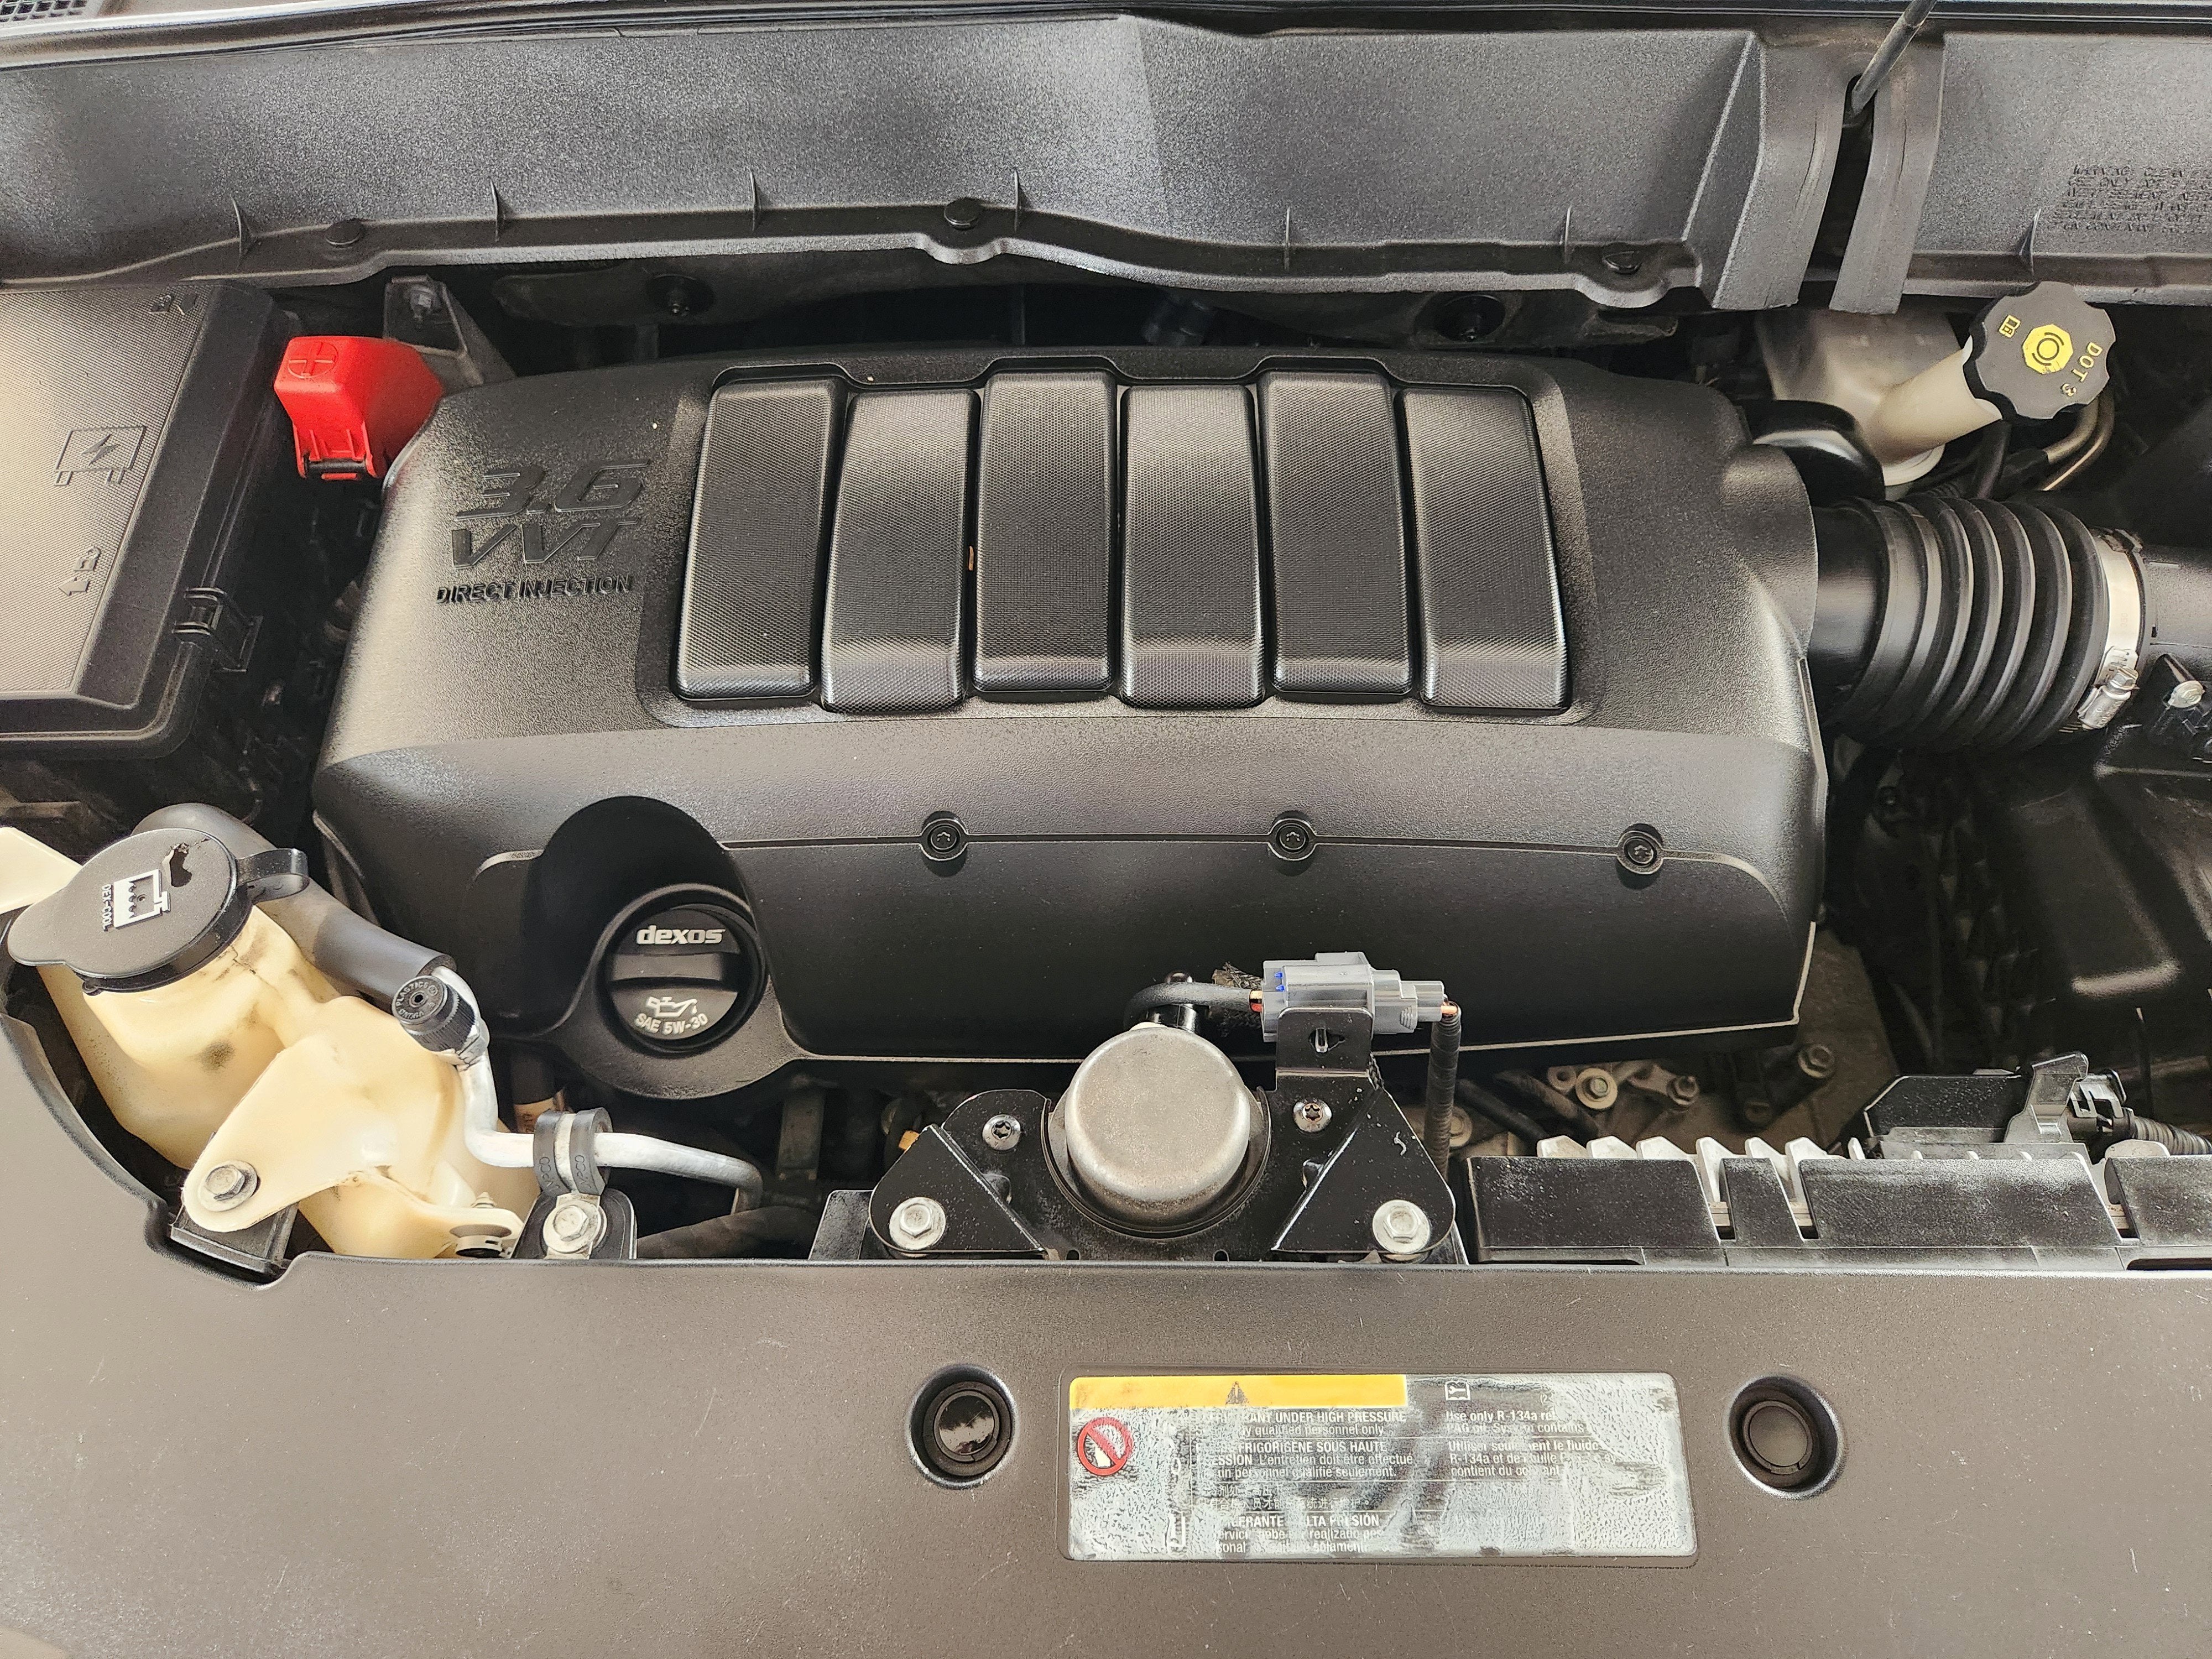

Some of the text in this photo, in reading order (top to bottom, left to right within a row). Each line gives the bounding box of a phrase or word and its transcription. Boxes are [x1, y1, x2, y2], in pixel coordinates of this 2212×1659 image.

[2062, 342, 2103, 397] DOT 3
[454, 460, 651, 521] 3.6
[451, 517, 639, 569] VVT
[436, 573, 633, 604] DIRECT INJECTION
[102, 884, 112, 930] DEX-COOL
[637, 925, 726, 945] dexos
[635, 1013, 708, 1035] SAE 5W-30
[1275, 1411, 1313, 1423] UNDER
[1317, 1411, 1344, 1423] HIGH
[1348, 1411, 1407, 1423] PRESSURE
[1470, 1410, 1494, 1423] only
[1496, 1410, 1537, 1421] R-134a
[1305, 1423, 1358, 1437] personnel
[1537, 1422, 1584, 1433] contains
[1316, 1441, 1347, 1453] SOUS
[1350, 1441, 1387, 1453] HAUTE
[1553, 1439, 1564, 1451] le
[1567, 1439, 1599, 1451] fluide
[1319, 1454, 1339, 1465] doit
[1449, 1453, 1489, 1464] R-134a
[1493, 1453, 1504, 1464] et
[1506, 1453, 1520, 1464] de
[1218, 1468, 1231, 1478] un
[1451, 1465, 1495, 1477] contient
[1498, 1465, 1512, 1476] du
